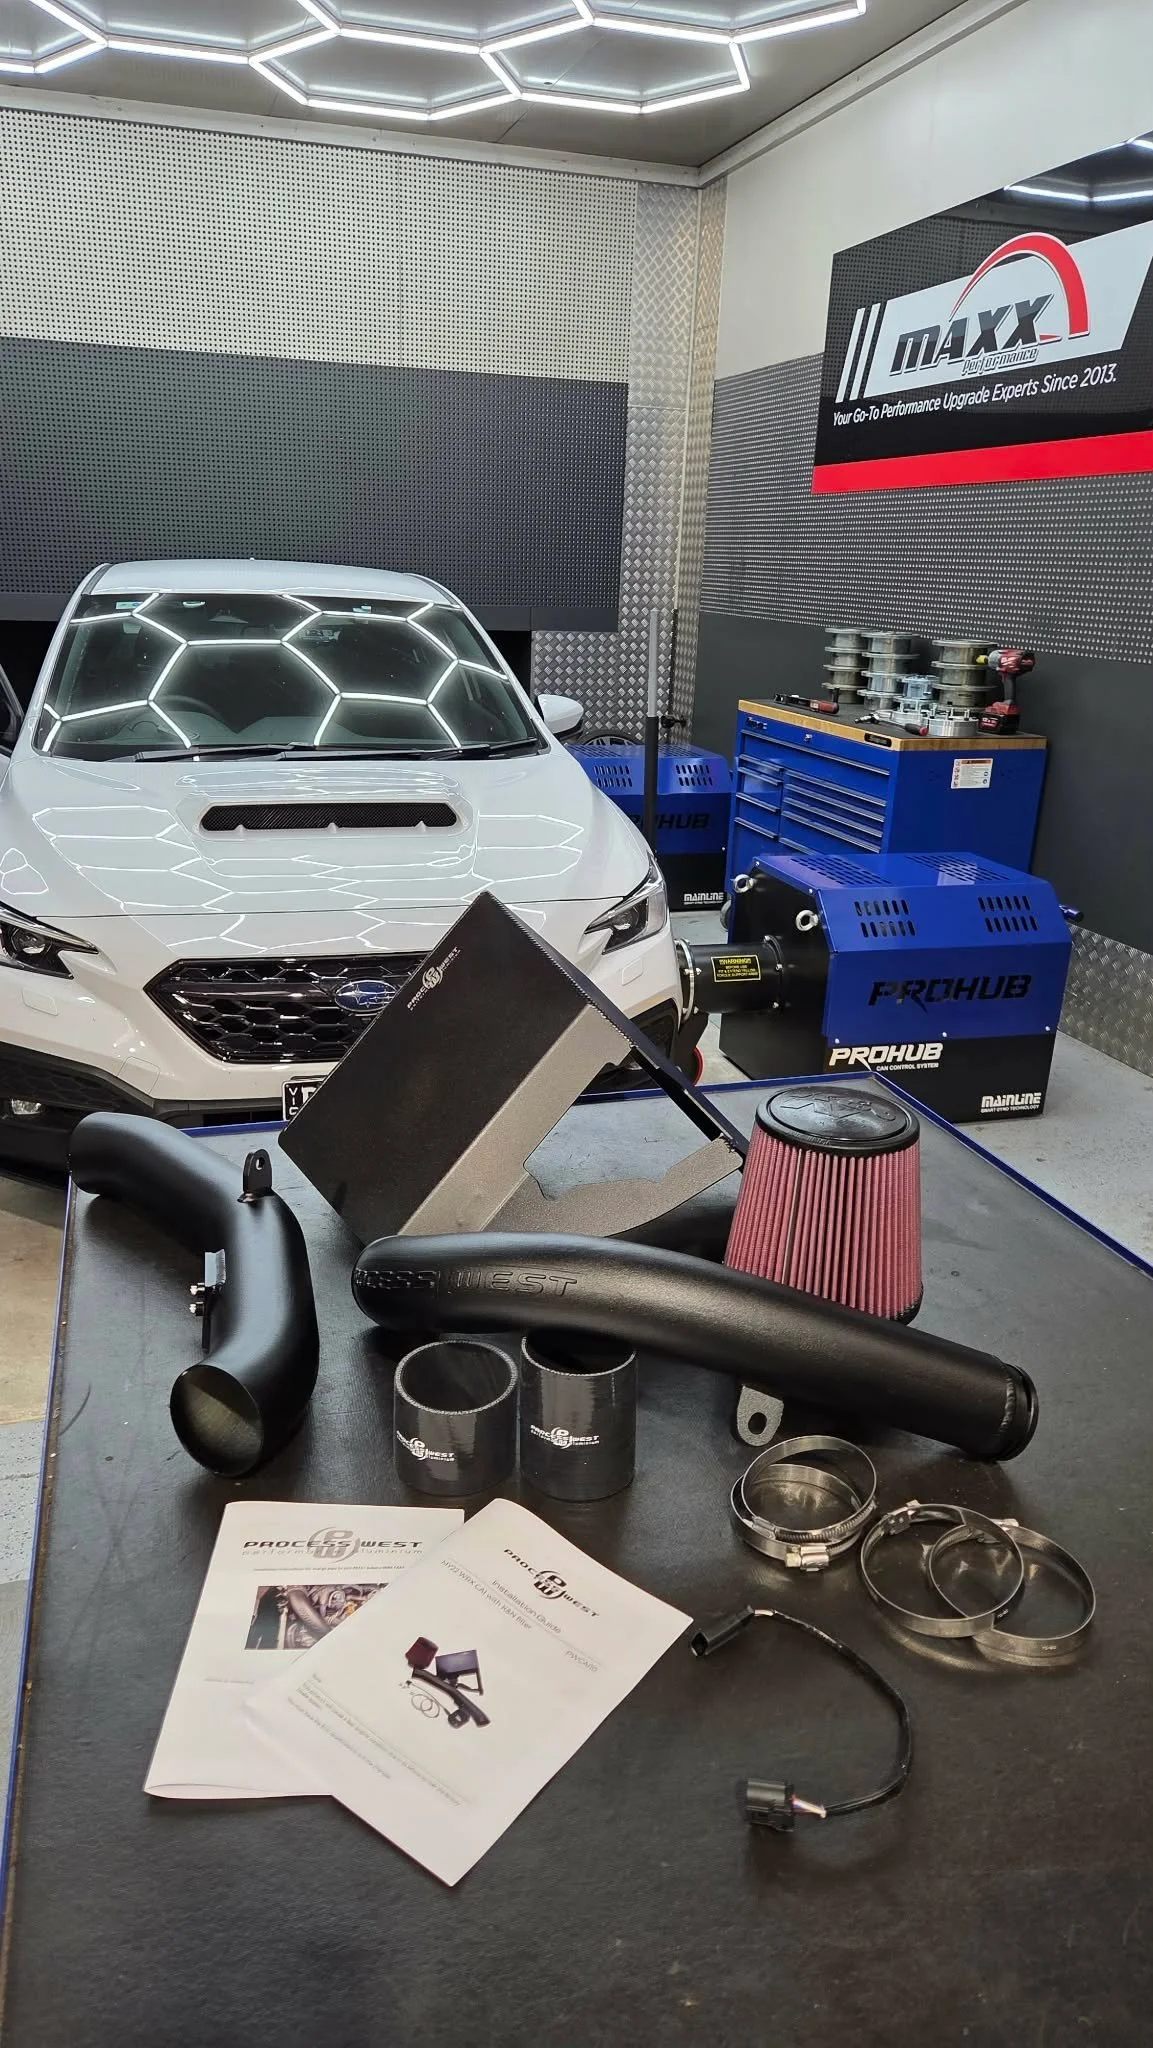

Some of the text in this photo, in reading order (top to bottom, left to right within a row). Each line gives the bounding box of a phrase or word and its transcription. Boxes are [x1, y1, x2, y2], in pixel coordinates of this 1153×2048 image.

[890, 294, 1054, 375] MAXX
[962, 348, 1038, 375] Performance
[833, 363, 1117, 426] Your Go-To Performance Upgrade Experts Since 2013.
[868, 975, 1032, 1014] PROHUB
[828, 1043, 944, 1071] PROHUB
[876, 1064, 889, 1072] CAN
[916, 1062, 940, 1070] SYSTEM
[288, 1087, 299, 1116] VIC
[981, 1092, 1042, 1108] MAINLINE
[243, 1540, 423, 1549] PROCESS WEST
[440, 1558, 460, 1573] MY22
[459, 1570, 475, 1586] WRX
[486, 1593, 501, 1608] with
[516, 1615, 532, 1630] filter
[492, 1580, 562, 1634] Installation Guide
[563, 1594, 600, 1617] WEST
